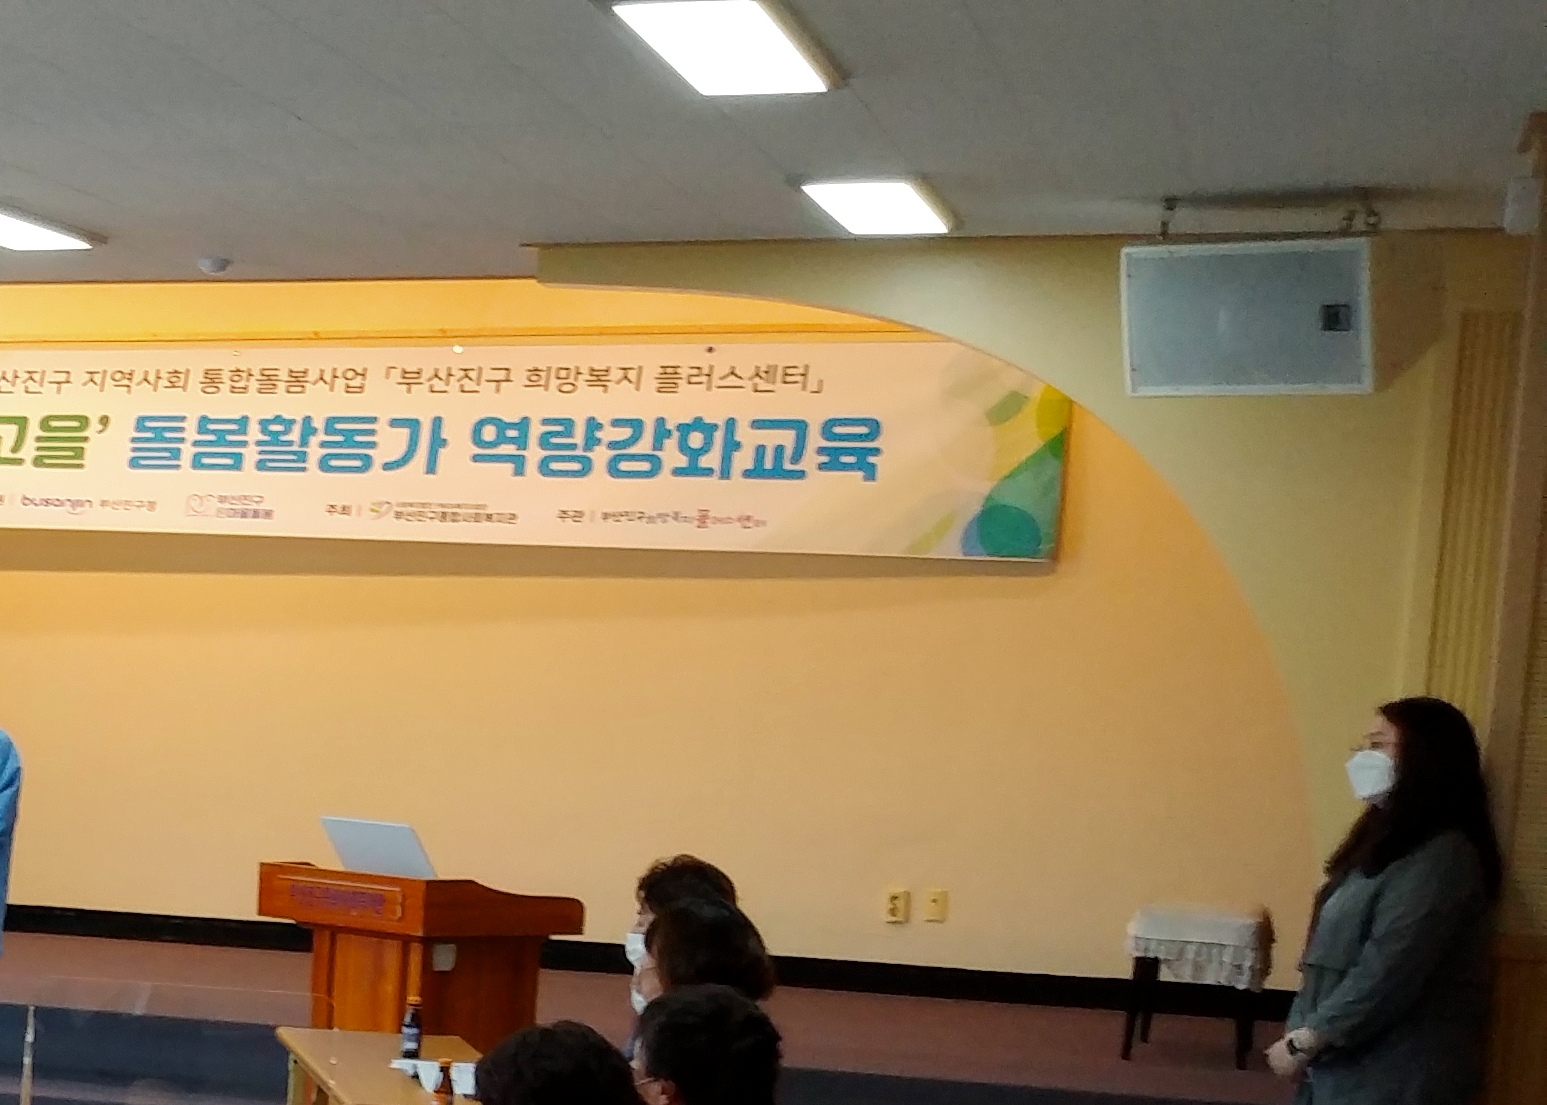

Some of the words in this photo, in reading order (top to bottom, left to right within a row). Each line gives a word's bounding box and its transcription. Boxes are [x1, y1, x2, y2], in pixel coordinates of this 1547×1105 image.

[82, 367, 192, 394] 지역사회
[198, 366, 368, 395] 통합돌봄사업
[523, 364, 644, 394] 희망복지
[127, 412, 449, 476] 돌봄활동가
[468, 414, 884, 483] 역량강화교육
